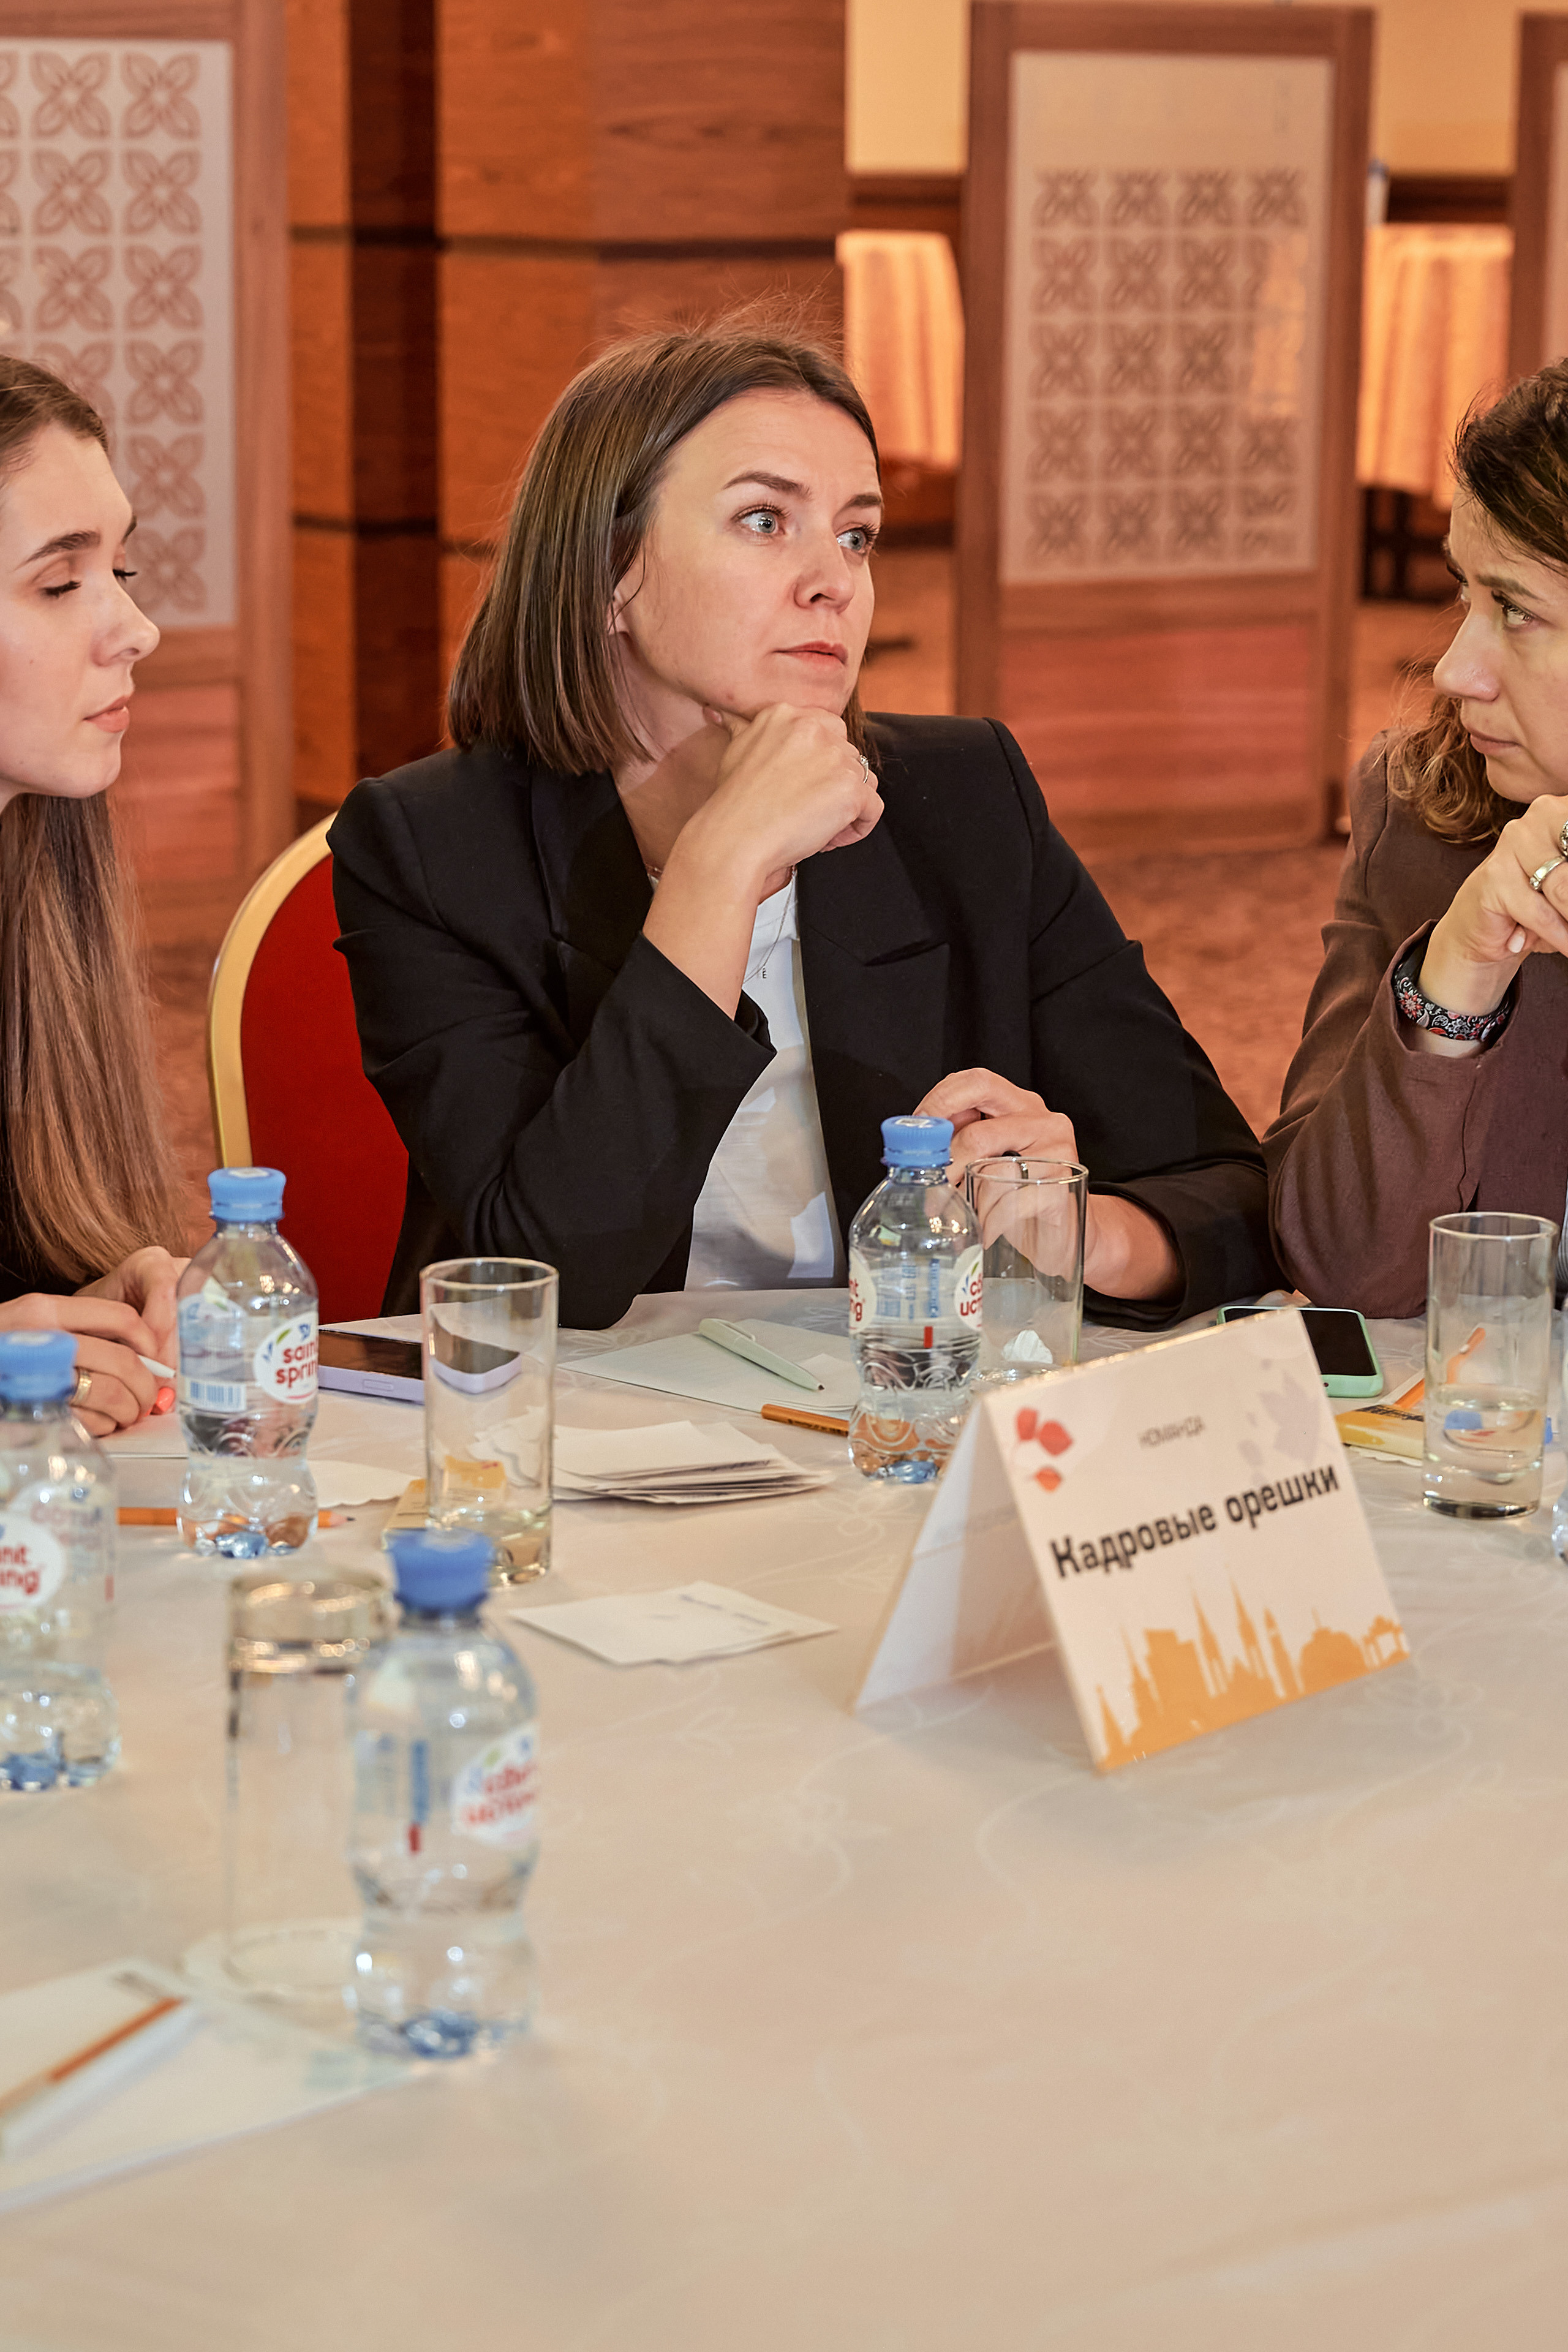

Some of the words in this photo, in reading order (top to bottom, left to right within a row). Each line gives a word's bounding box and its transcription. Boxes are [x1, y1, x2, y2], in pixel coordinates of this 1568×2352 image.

[283, 1337, 318, 1363] sain
[276, 1360, 318, 1389] sprin
[1050, 1503, 1218, 1578] Кадровые
[1225, 1465, 1340, 1529] орешки
